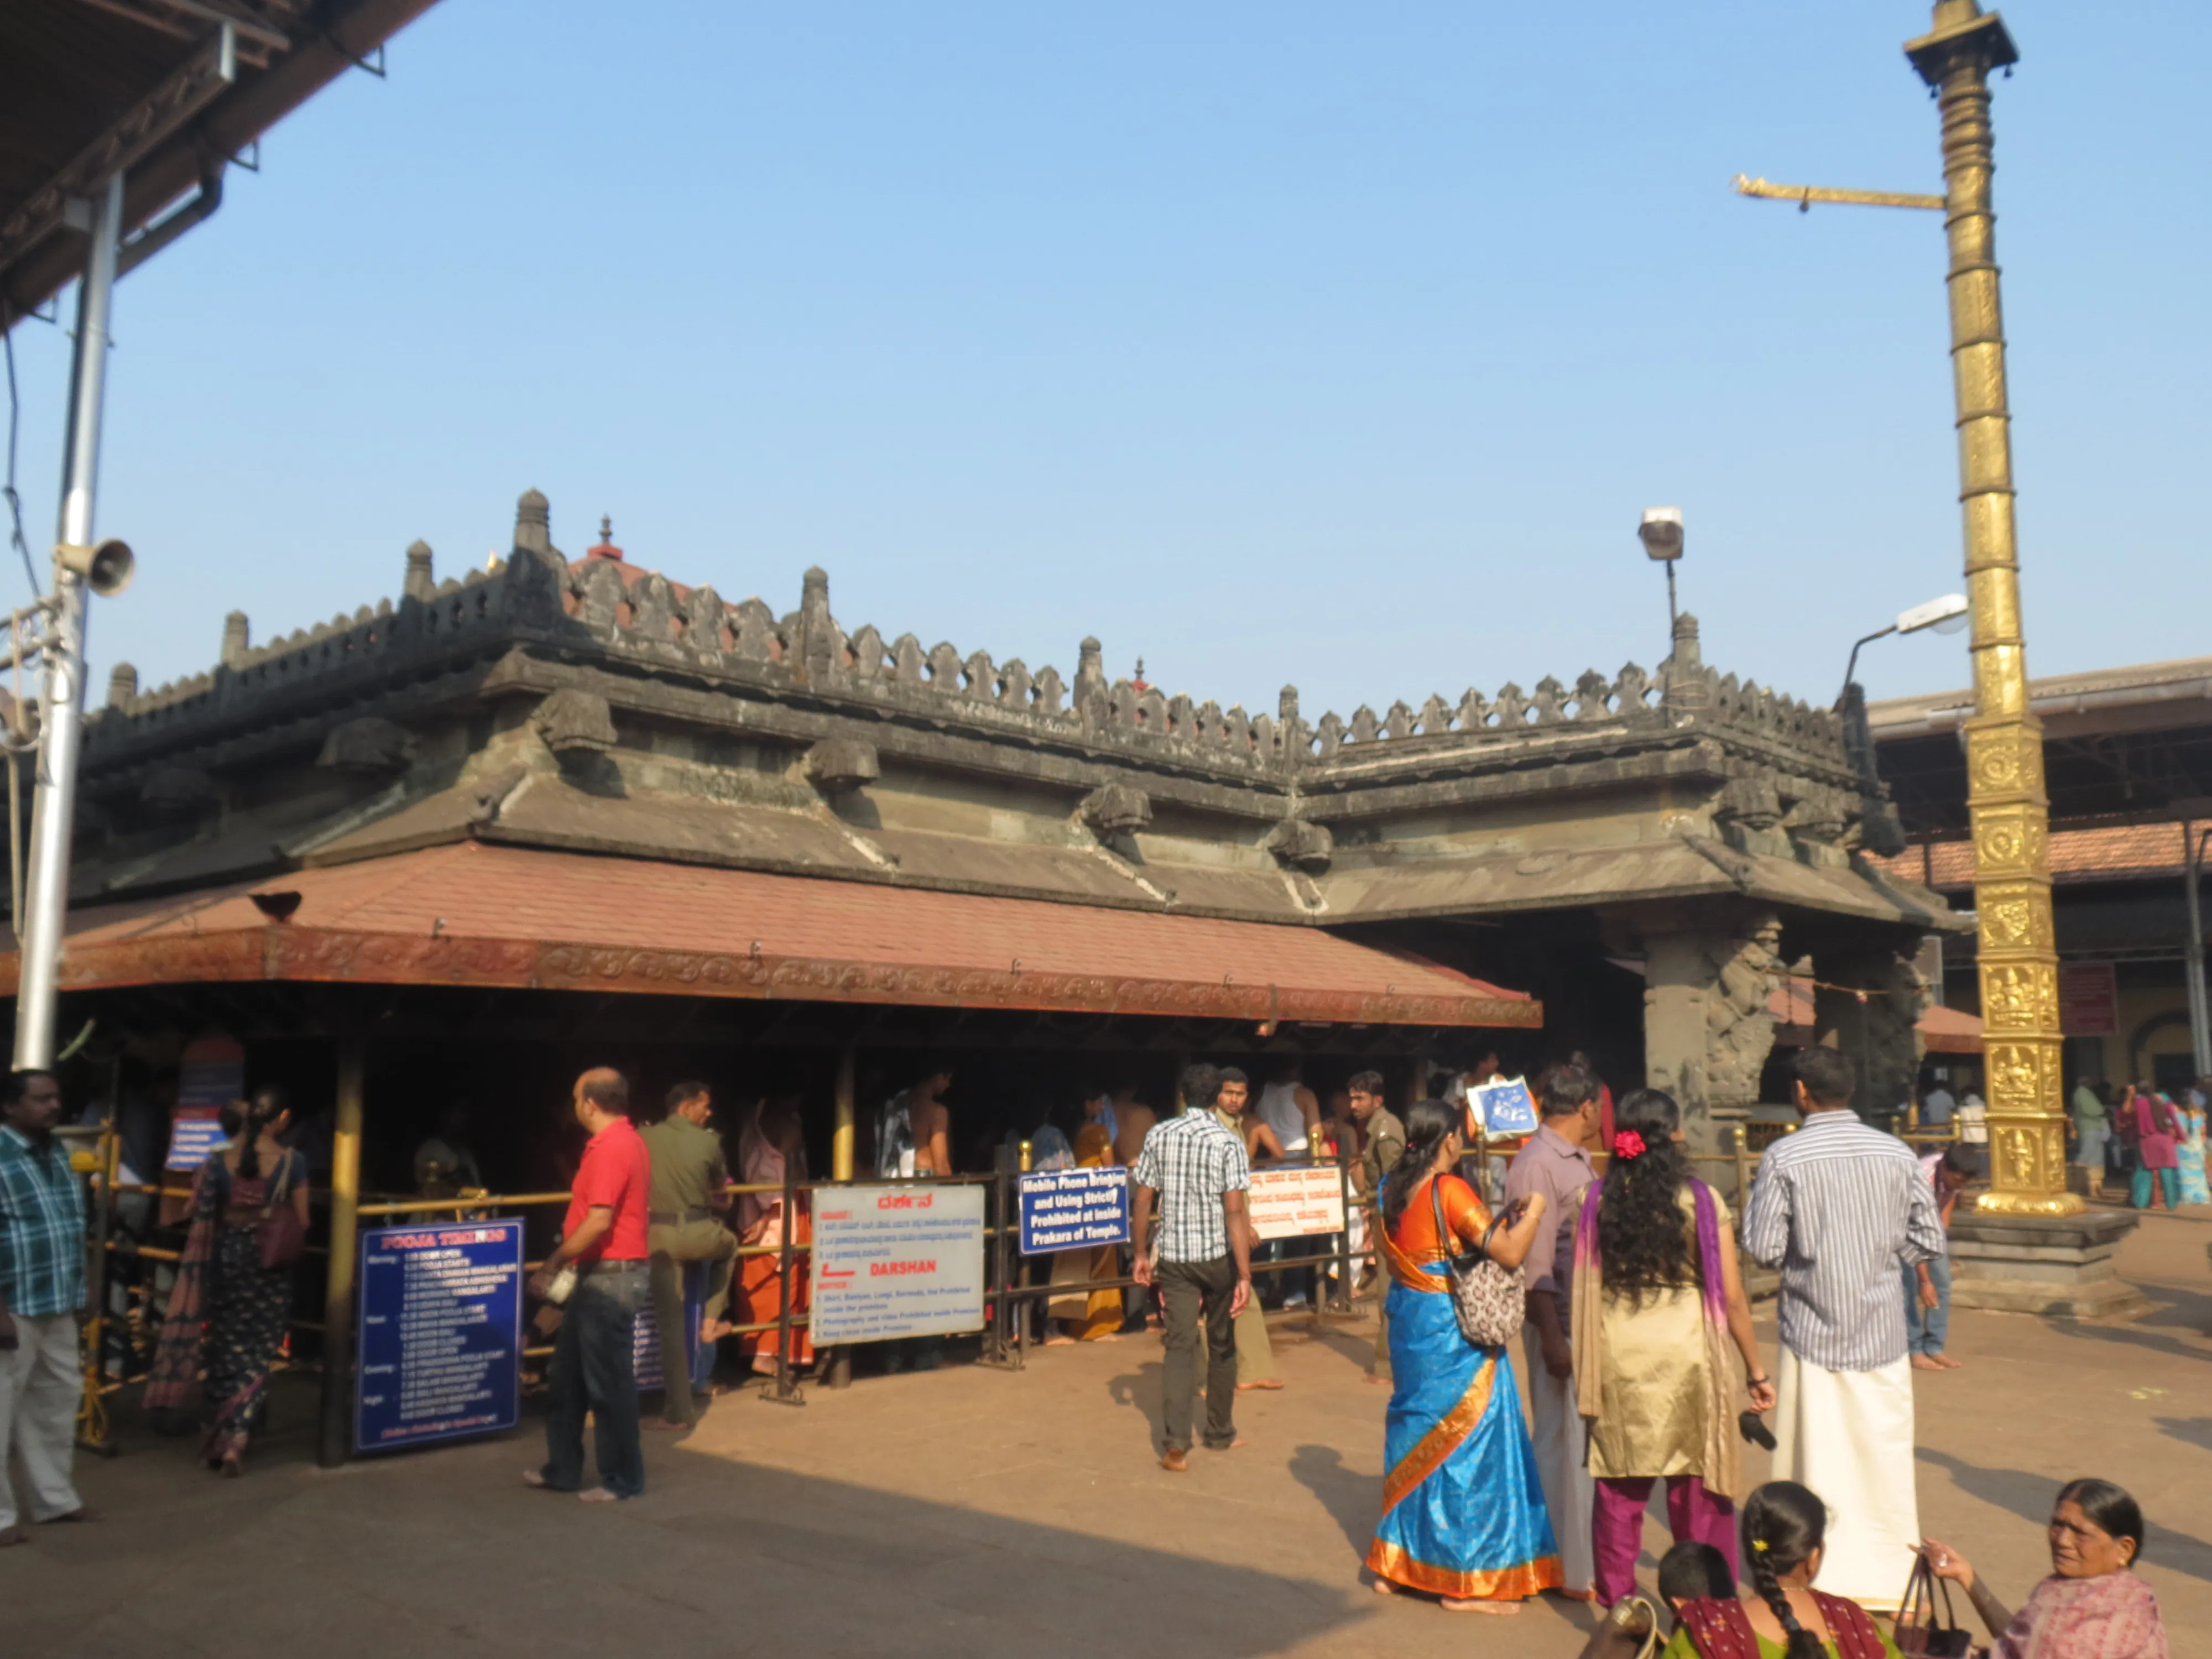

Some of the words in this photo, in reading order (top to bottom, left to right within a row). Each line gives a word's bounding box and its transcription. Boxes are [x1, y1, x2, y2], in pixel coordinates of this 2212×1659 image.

[1023, 1178, 1056, 1193] Mobile
[1058, 1176, 1088, 1190] Phone
[1089, 1172, 1125, 1187] Bringing
[1034, 1196, 1053, 1209] and
[1055, 1194, 1082, 1208] Using
[1031, 1211, 1082, 1228] Prohibited
[1083, 1210, 1093, 1222] at
[382, 1234, 437, 1250] POOJA
[439, 1228, 507, 1246] TIMINGS
[1032, 1232, 1072, 1245] Prakara
[1074, 1227, 1084, 1240] of
[870, 1260, 937, 1277] DARSHAN
